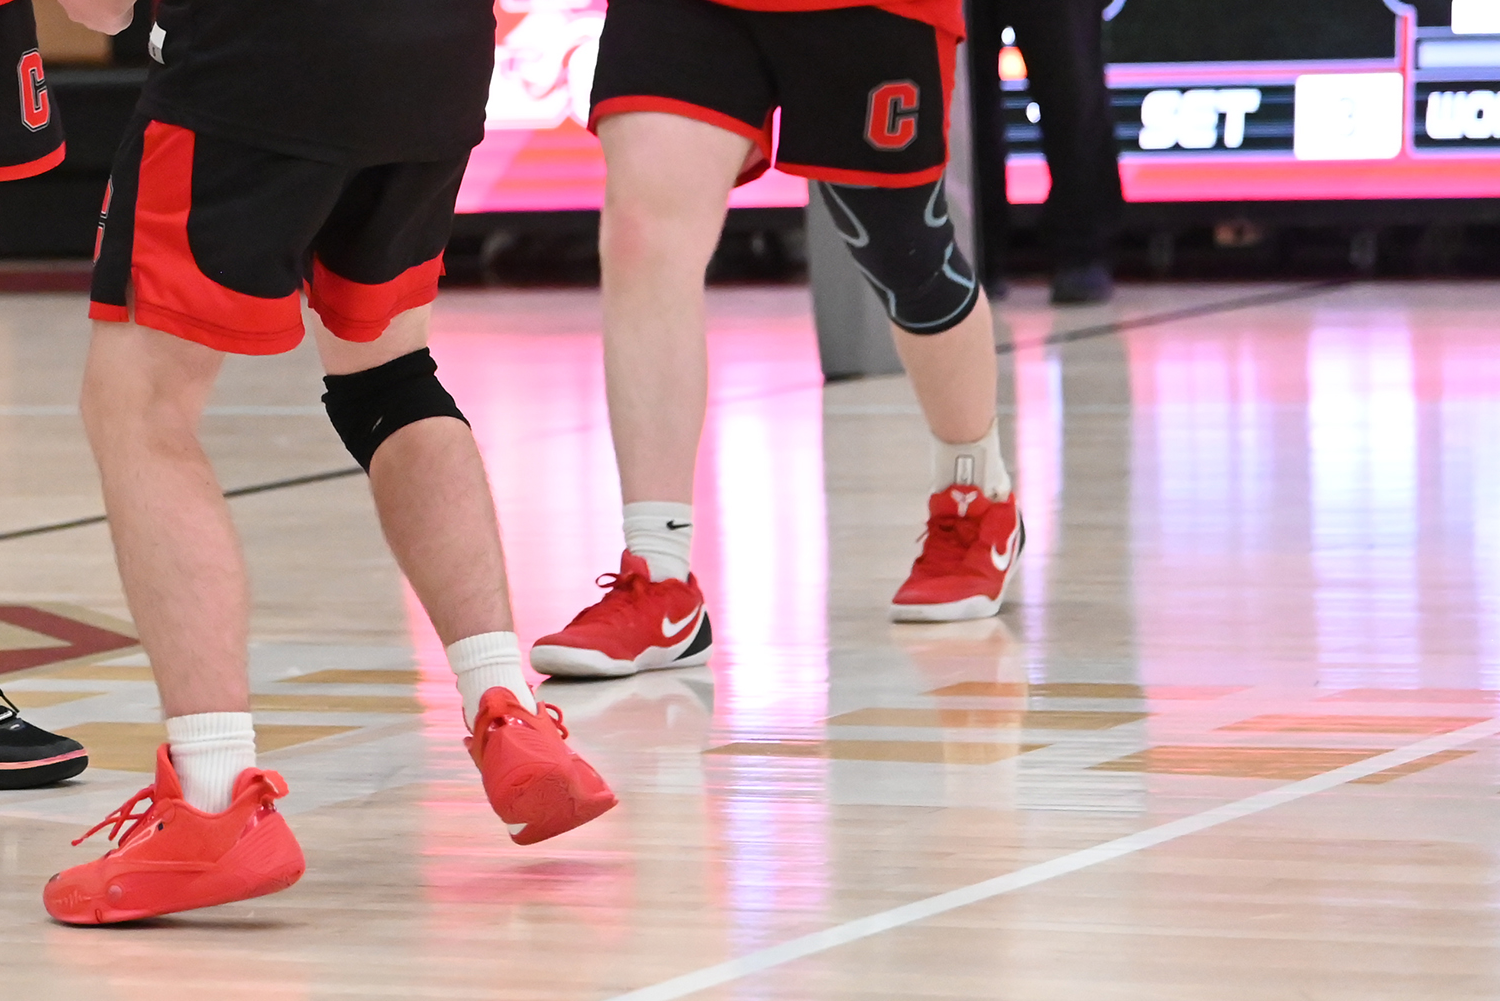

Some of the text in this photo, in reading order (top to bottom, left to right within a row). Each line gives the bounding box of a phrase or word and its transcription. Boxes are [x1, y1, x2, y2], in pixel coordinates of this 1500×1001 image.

[17, 48, 50, 132] C
[863, 79, 921, 151] C
[1139, 89, 1261, 149] SET
[1426, 90, 1500, 139] WO
